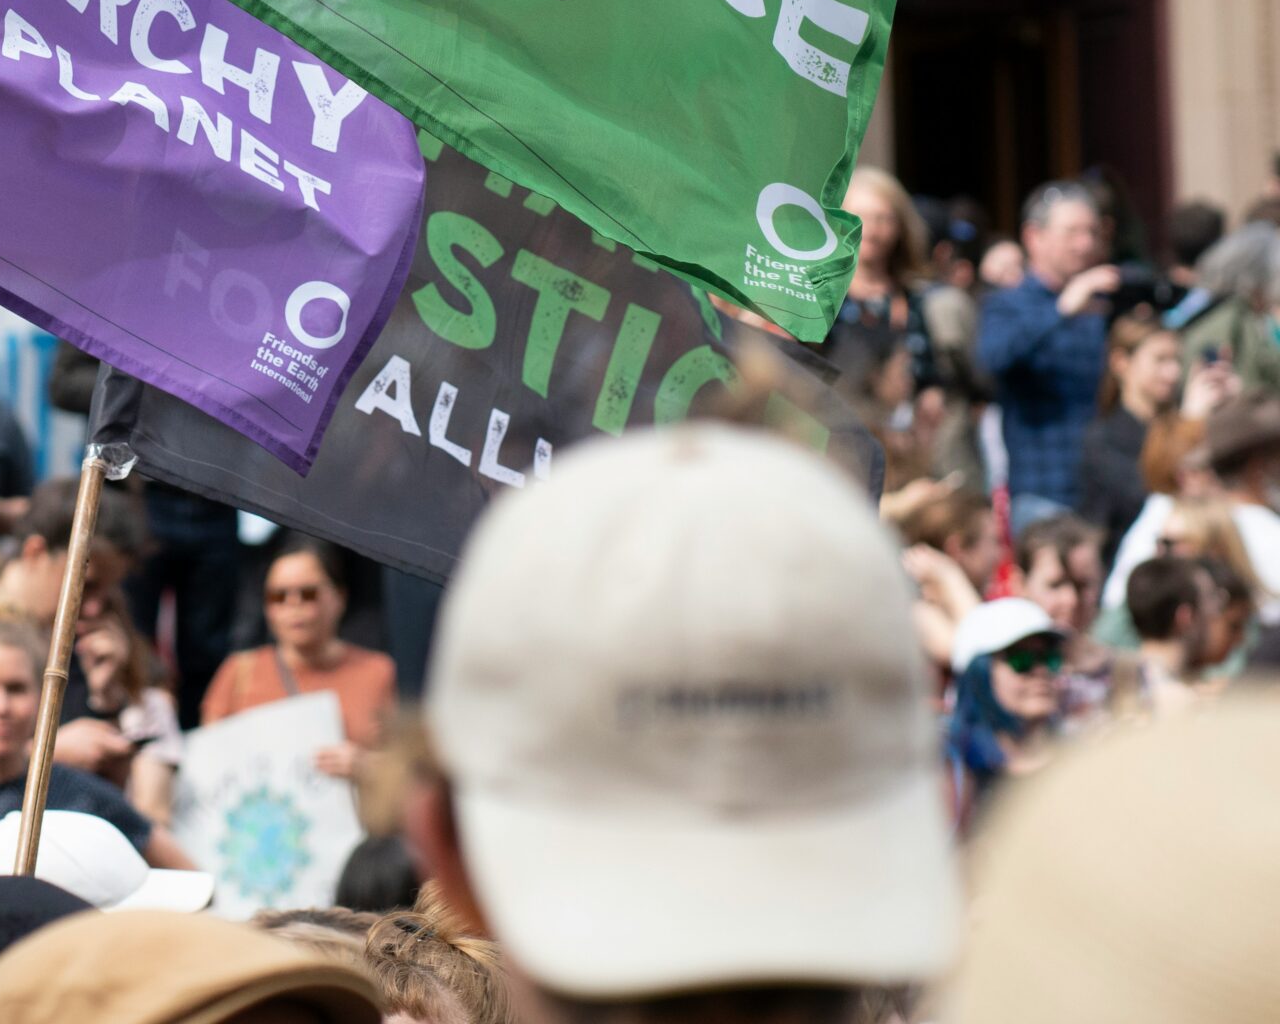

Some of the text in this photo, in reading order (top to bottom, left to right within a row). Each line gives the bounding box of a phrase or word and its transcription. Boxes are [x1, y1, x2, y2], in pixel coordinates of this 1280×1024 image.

[1, 8, 332, 212] PLANET
[744, 261, 781, 281] the
[745, 243, 810, 275] Frien
[743, 276, 817, 303] Internati
[256, 346, 320, 393] the Earth
[261, 332, 329, 380] Friends of
[250, 359, 313, 405] International
